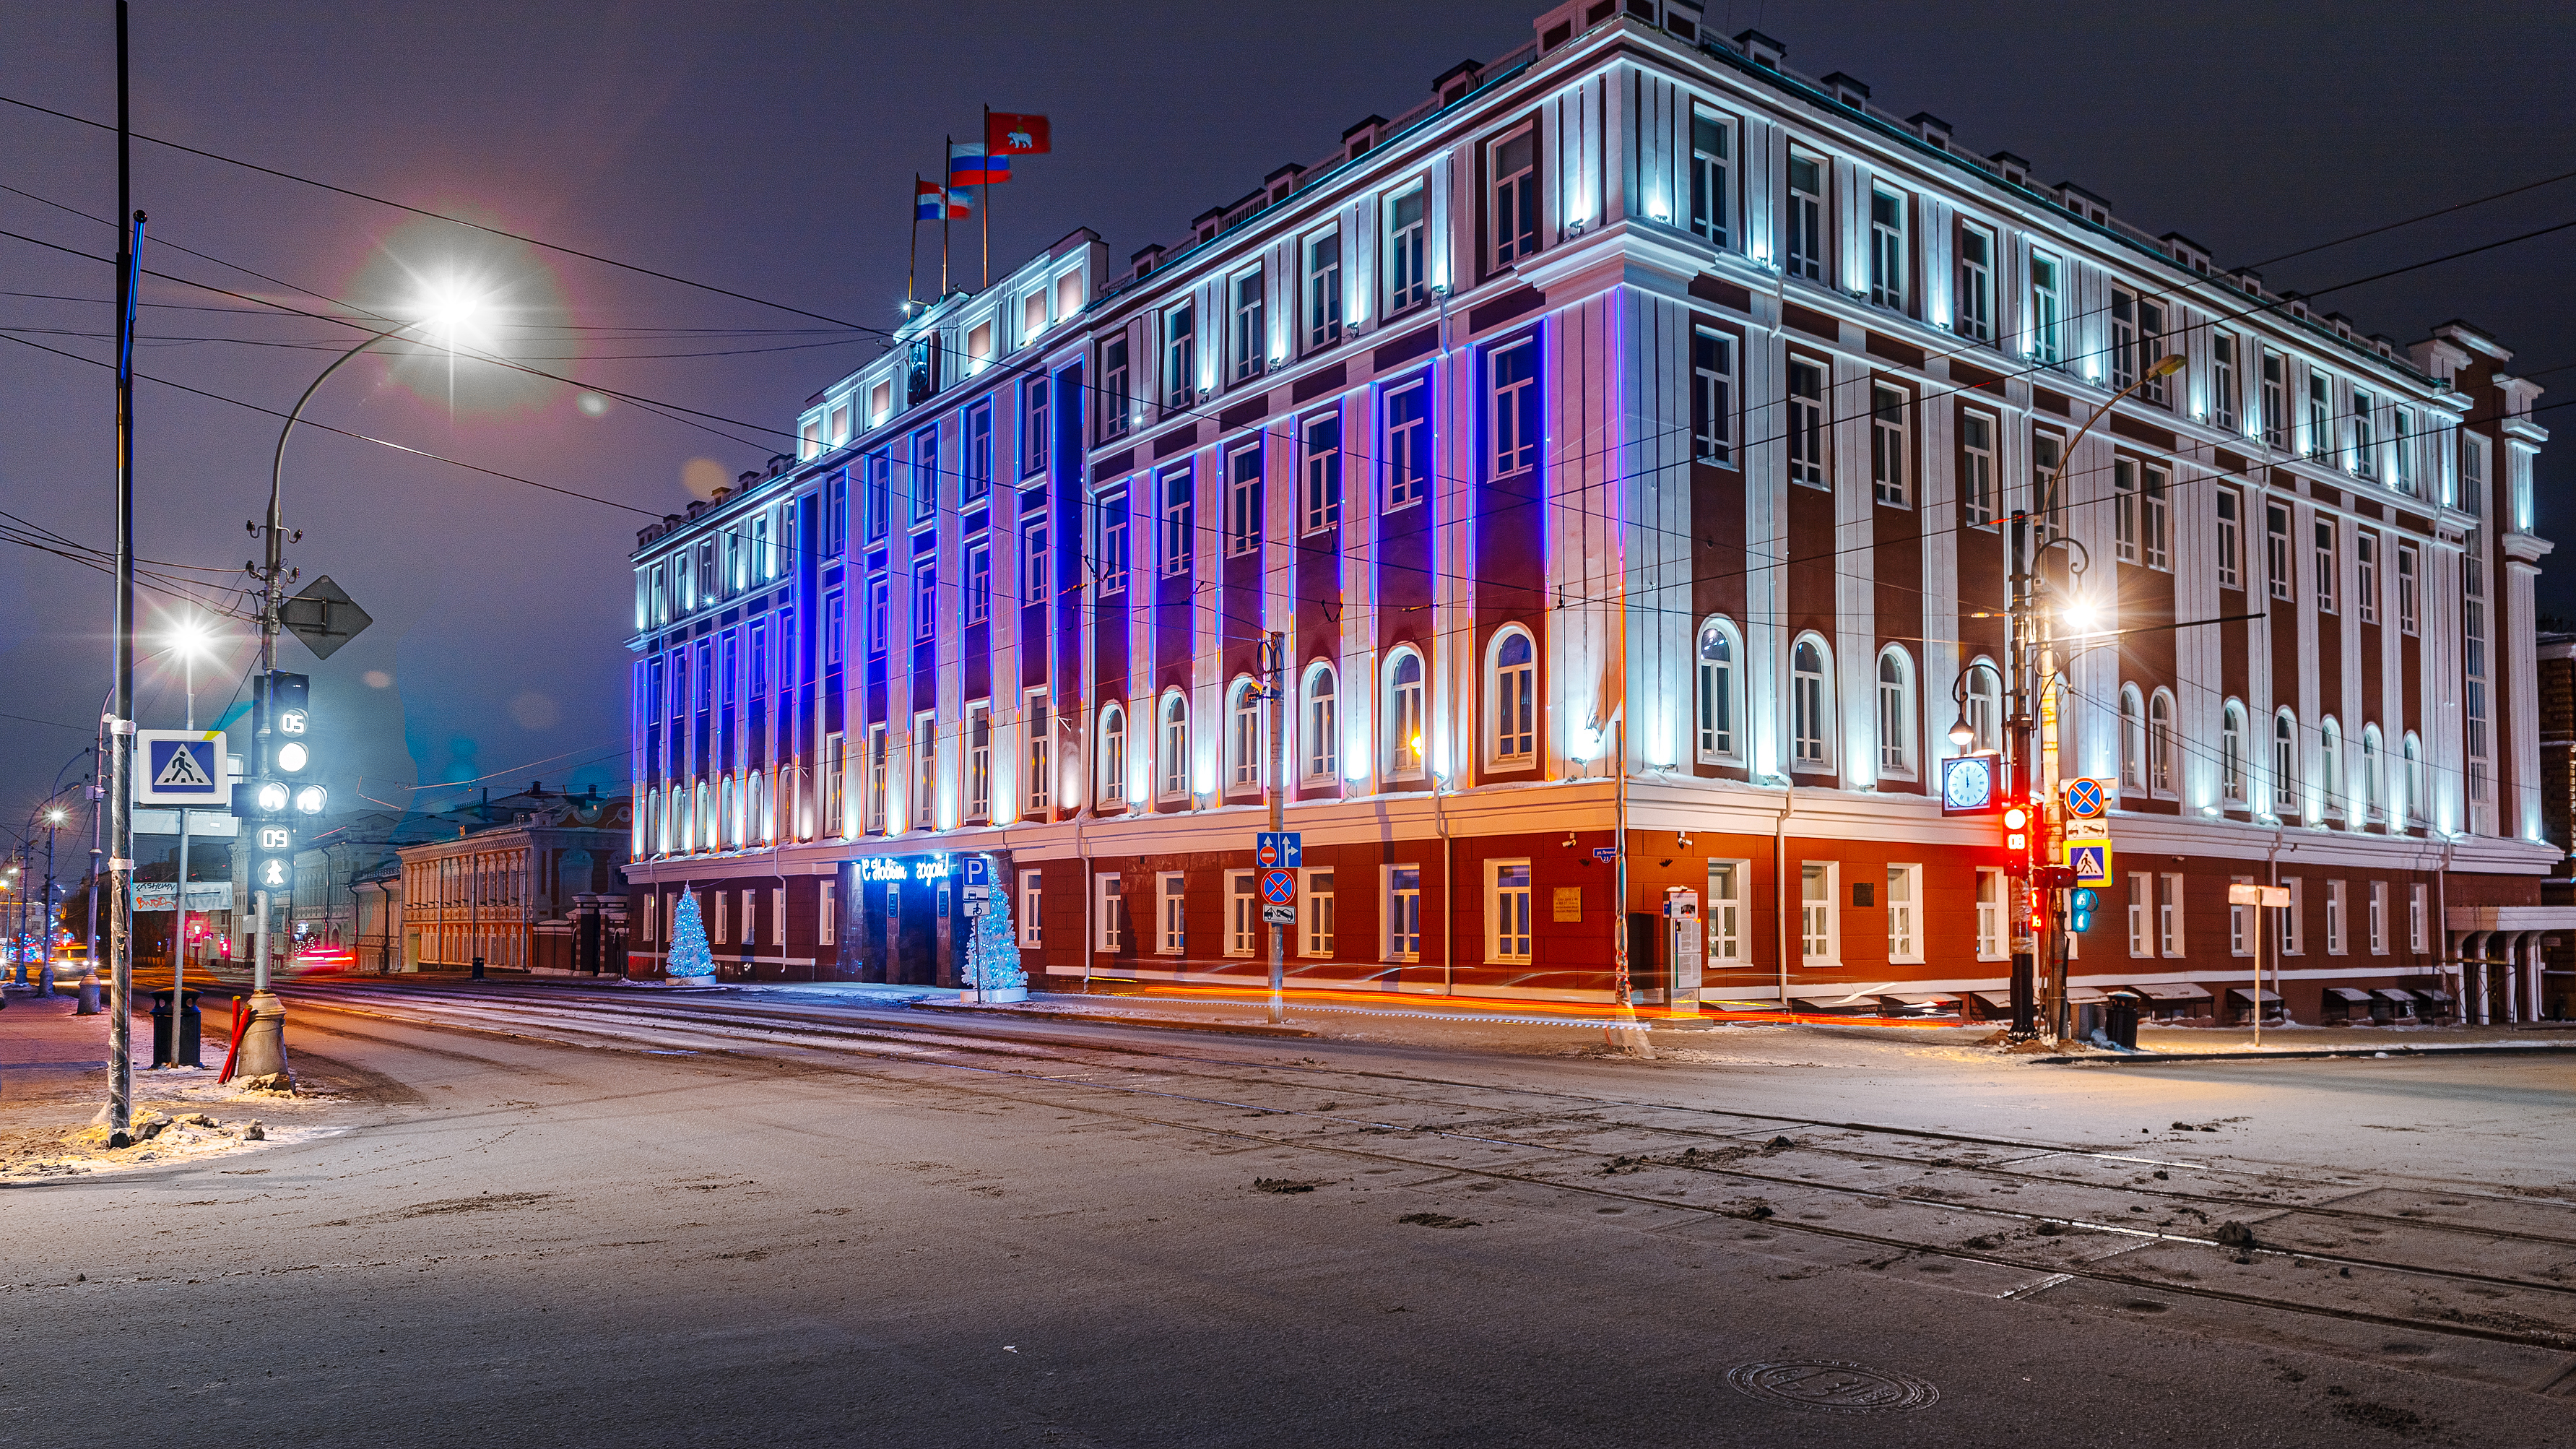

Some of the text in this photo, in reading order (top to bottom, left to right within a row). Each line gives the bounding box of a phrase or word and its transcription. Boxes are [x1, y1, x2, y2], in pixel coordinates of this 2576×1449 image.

[282, 714, 305, 733] 05
[262, 829, 288, 848] 09
[871, 857, 907, 881] Новым
[916, 852, 949, 887] годом!
[968, 860, 983, 883] P
